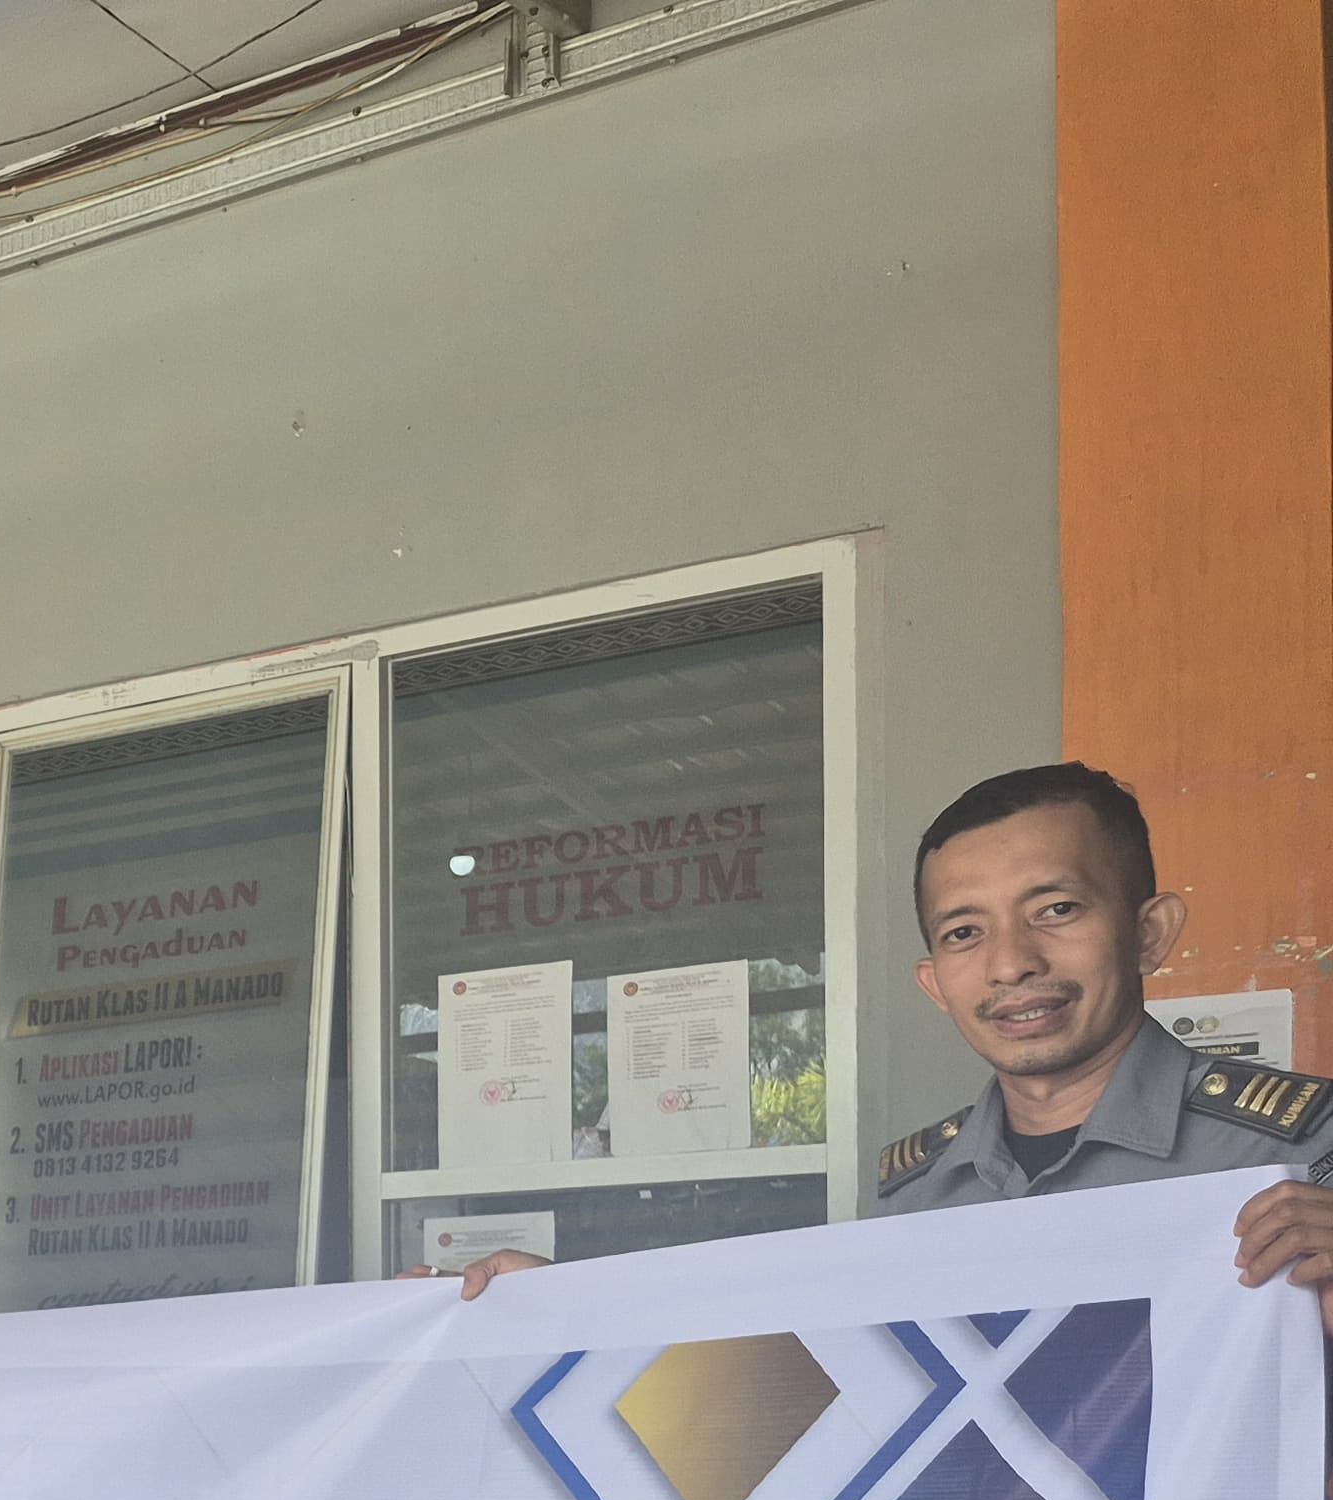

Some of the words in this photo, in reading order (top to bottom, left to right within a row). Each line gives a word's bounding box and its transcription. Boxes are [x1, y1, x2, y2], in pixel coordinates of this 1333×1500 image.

[454, 803, 766, 878] REFORMASI
[460, 846, 764, 936] HUKUM
[27, 998, 90, 1026] RUTAN
[96, 988, 148, 1020] KLAS
[154, 983, 168, 1011] II
[174, 980, 187, 1009] A
[194, 971, 284, 1006] MANADO
[15, 1057, 27, 1084] 1.
[39, 1051, 119, 1082] APLIKASI
[37, 1076, 196, 1108] www.LAPOR.go.id
[10, 1126, 25, 1154] 2.
[35, 1120, 74, 1153] SMS
[78, 1114, 194, 1150] PENGADUAN
[33, 1156, 76, 1178] 0813
[82, 1152, 126, 1174] 4132
[5, 1196, 20, 1224] 3.
[30, 1194, 70, 1221] UNIT
[75, 1188, 156, 1218] LAYANAN
[161, 1181, 270, 1212] PENGADUAN
[28, 1228, 83, 1256] RUTAN
[87, 1223, 133, 1253] KLAS
[154, 1221, 166, 1249] A
[172, 1217, 249, 1246] MANADO
